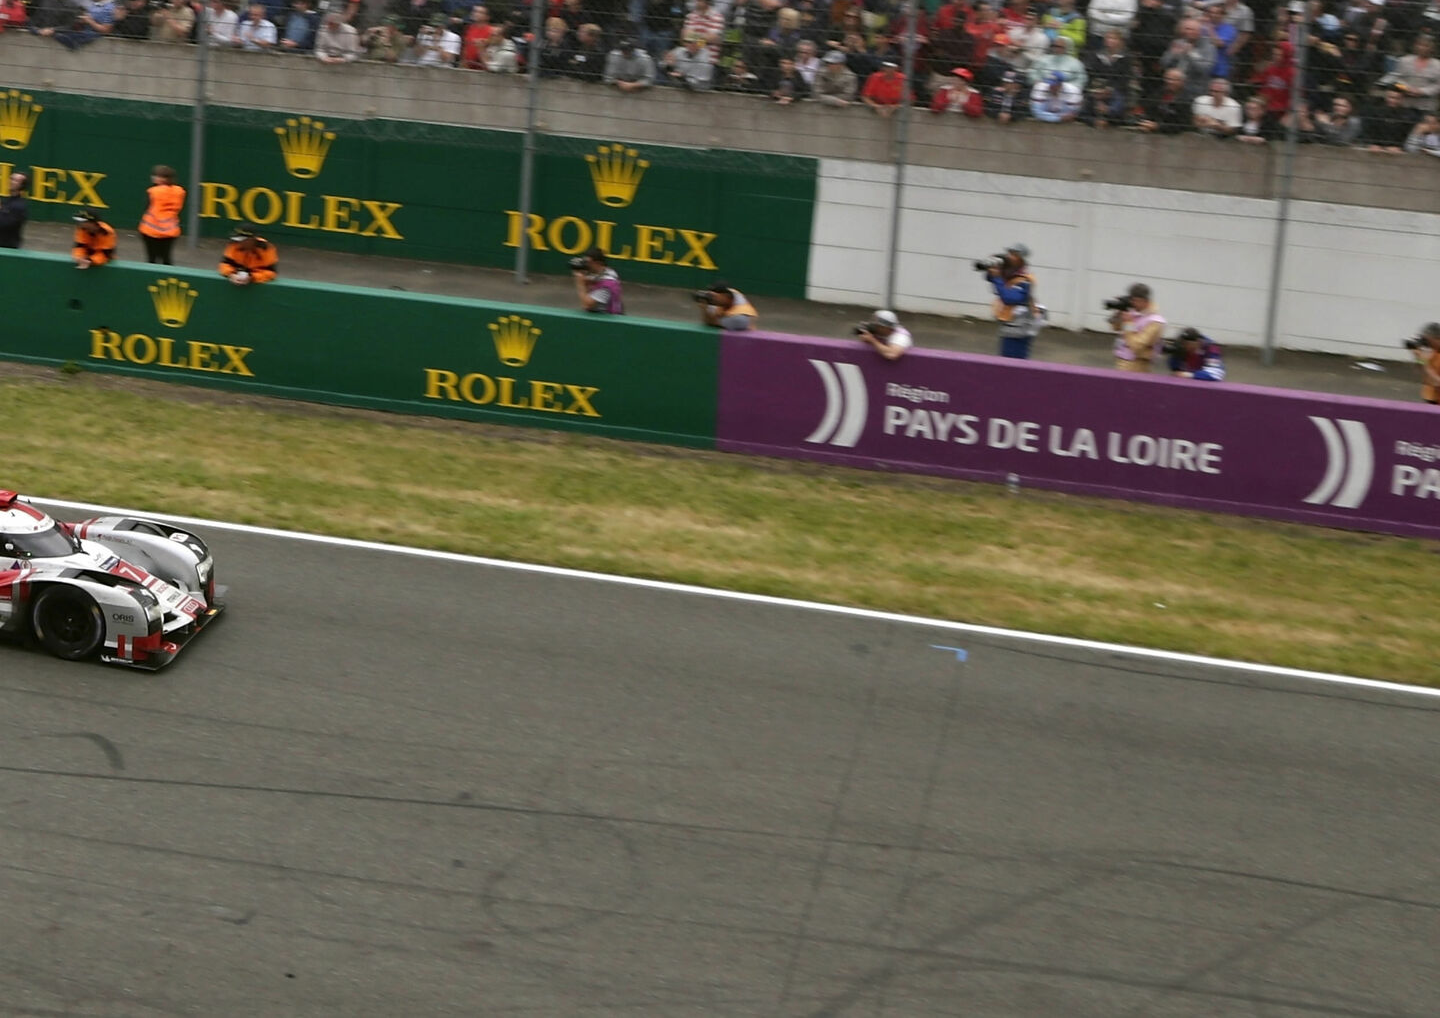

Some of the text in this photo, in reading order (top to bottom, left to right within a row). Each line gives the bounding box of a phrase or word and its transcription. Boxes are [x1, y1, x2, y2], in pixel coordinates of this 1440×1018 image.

[197, 181, 405, 241] ROLEX
[502, 209, 720, 272] ROLEX
[88, 328, 255, 378] ROLEX
[422, 367, 602, 419] ROLEX
[885, 382, 951, 404] Région
[883, 404, 1224, 476] PAYS DE LA LOIRE
[112, 612, 135, 624] ORIS
